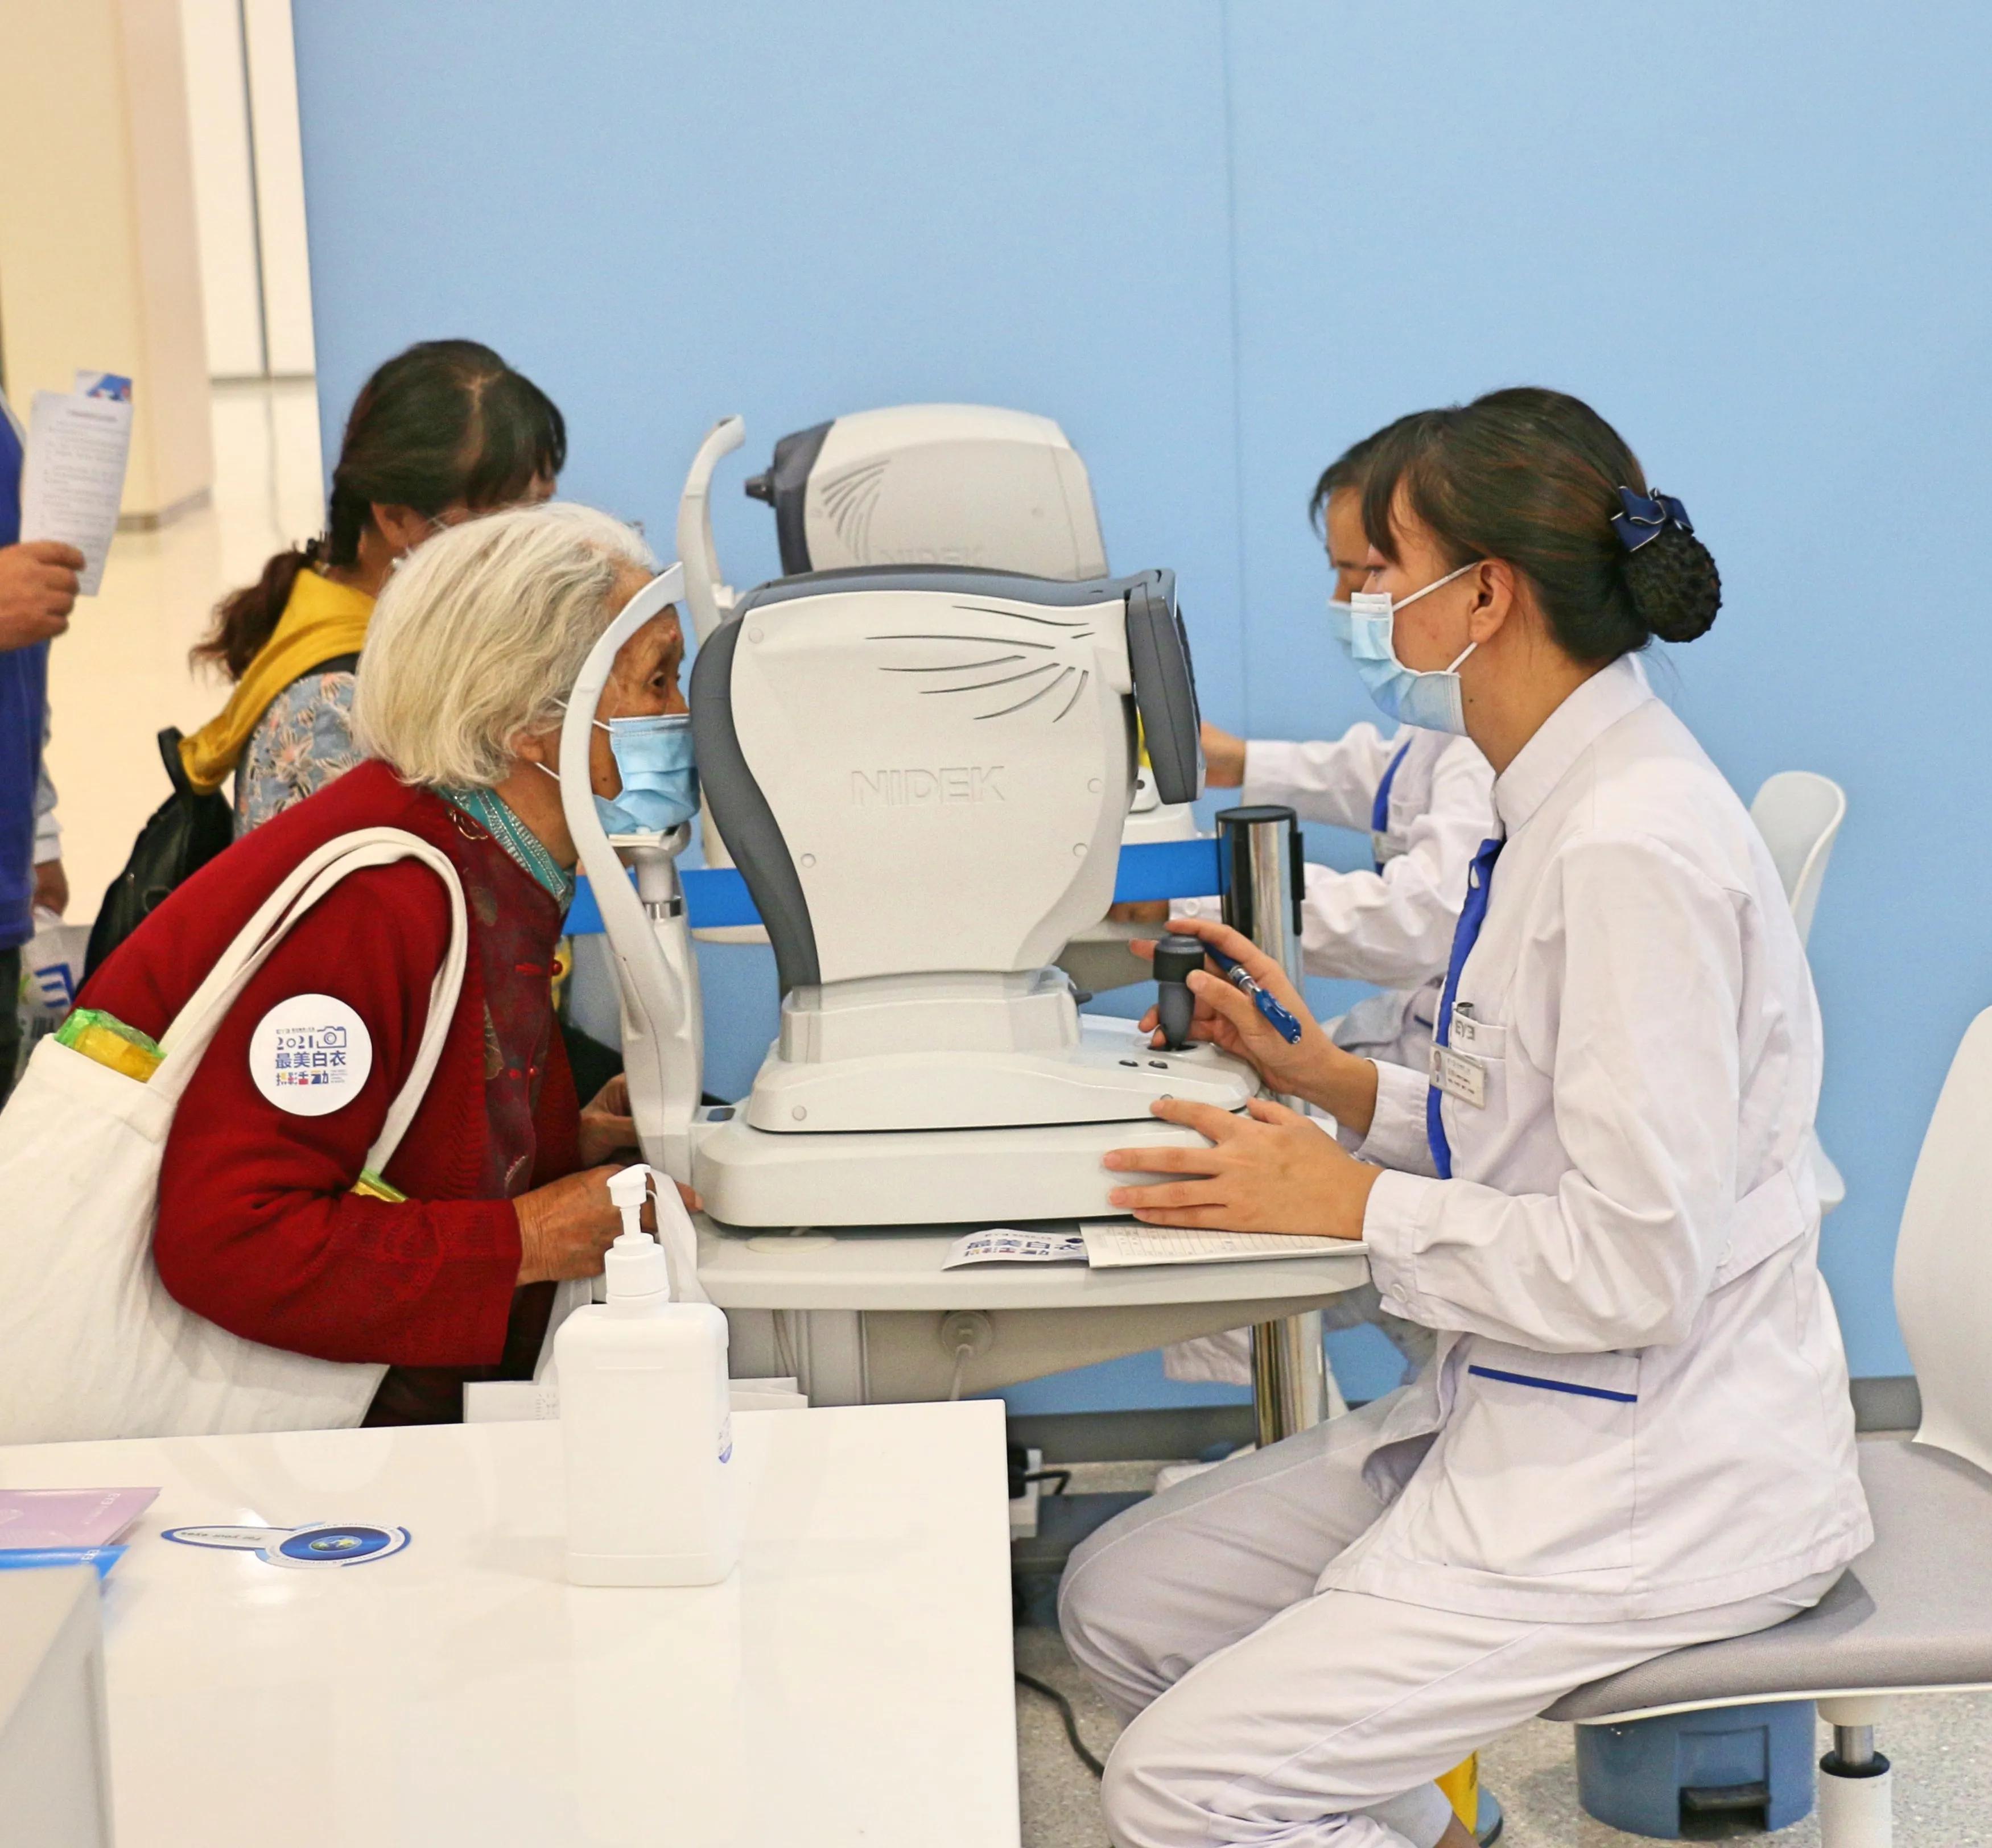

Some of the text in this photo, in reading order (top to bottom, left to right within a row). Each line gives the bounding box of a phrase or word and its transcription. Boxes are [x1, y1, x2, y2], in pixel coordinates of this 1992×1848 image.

[851, 765, 1005, 806] NIDEK
[277, 1035, 313, 1050] 2021
[276, 1050, 346, 1069] 最美白衣
